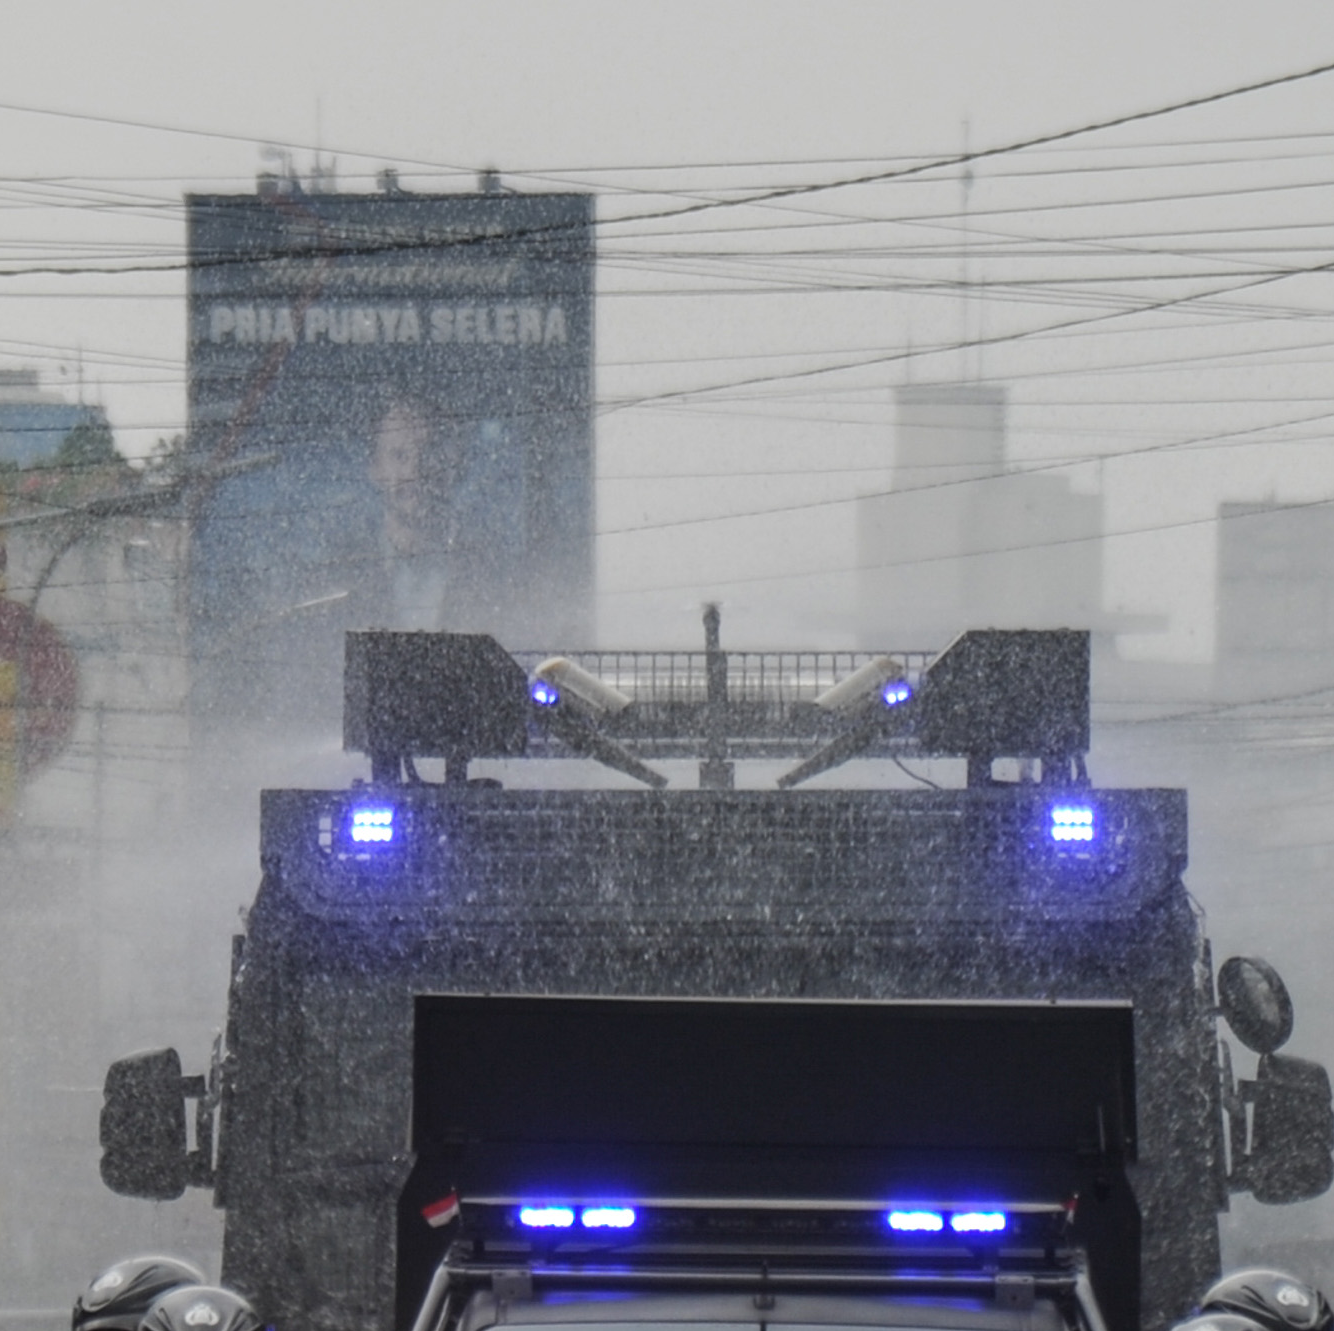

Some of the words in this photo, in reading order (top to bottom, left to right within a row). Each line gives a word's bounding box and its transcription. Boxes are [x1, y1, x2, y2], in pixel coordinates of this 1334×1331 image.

[210, 306, 296, 345] PRIA
[304, 306, 419, 345] PUNYA
[430, 307, 567, 346] SELERA
